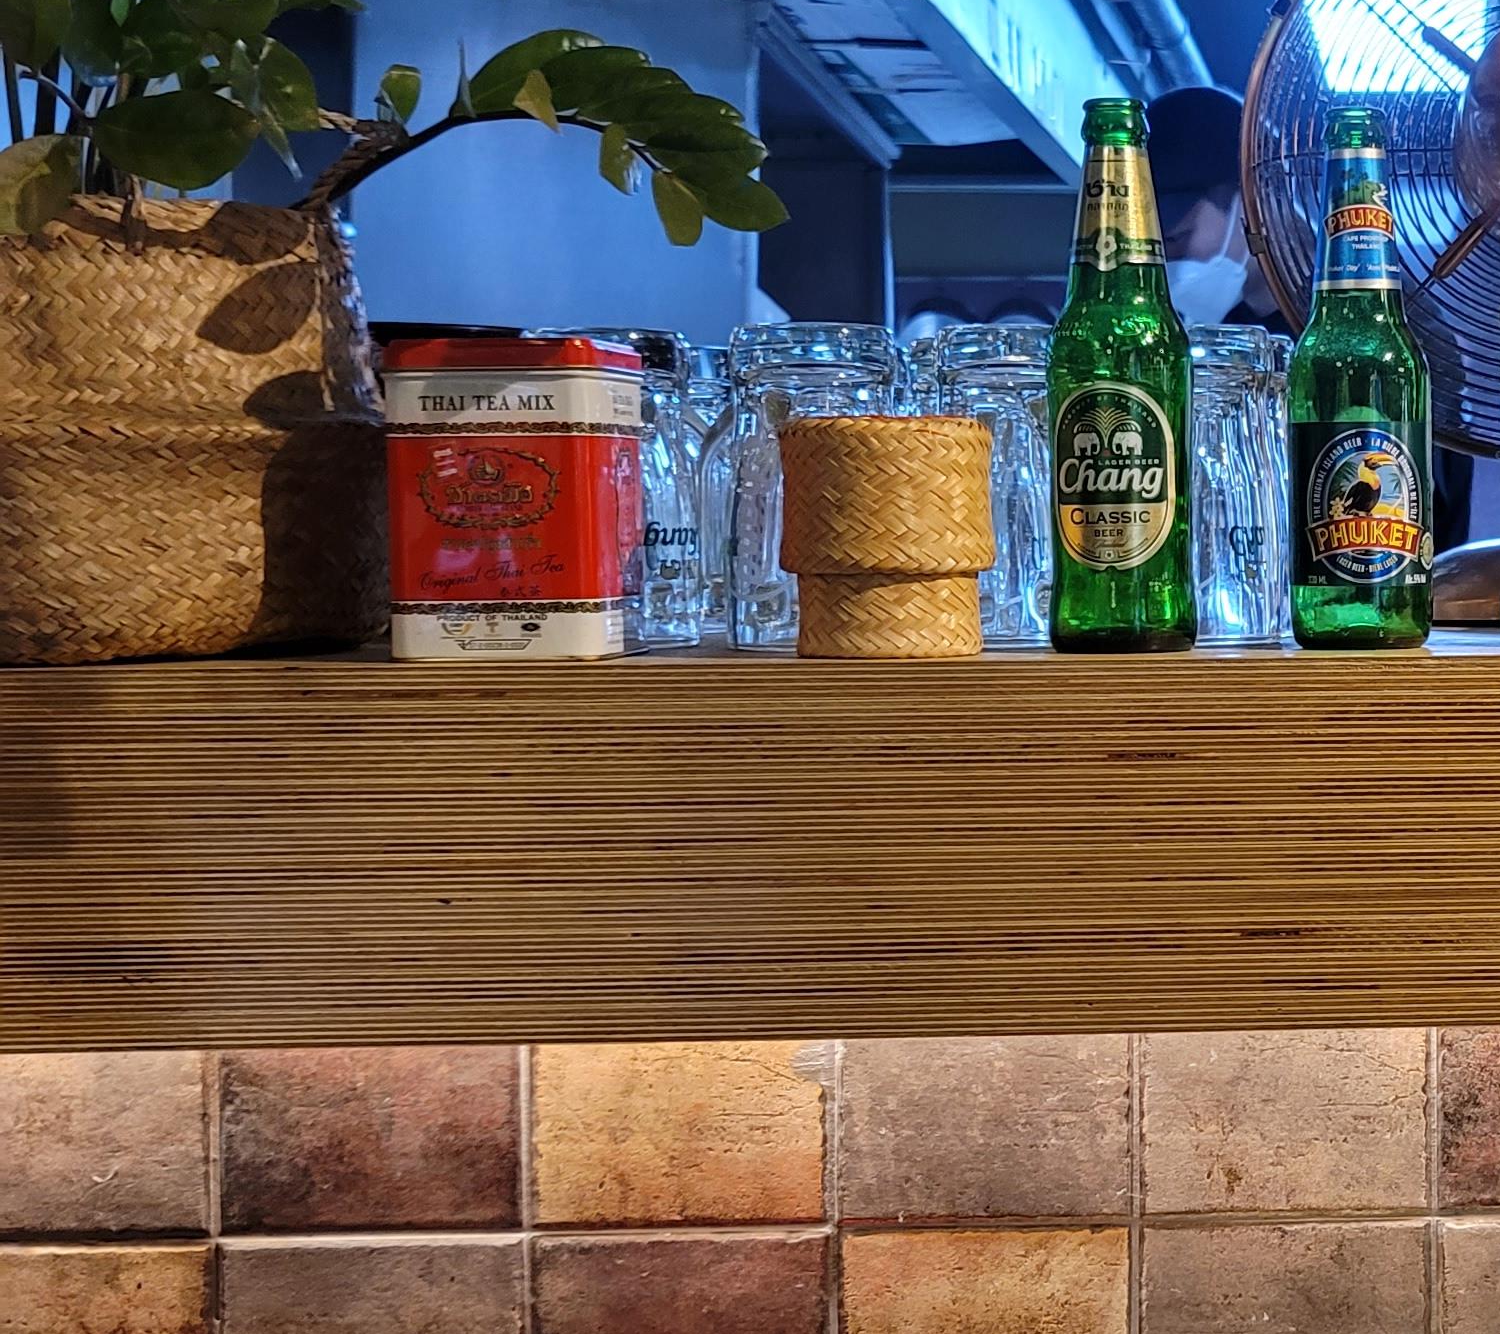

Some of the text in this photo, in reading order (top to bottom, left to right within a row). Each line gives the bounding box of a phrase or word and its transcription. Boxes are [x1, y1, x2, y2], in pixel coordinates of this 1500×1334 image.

[1327, 208, 1393, 234] PHUKET
[418, 394, 555, 411] THAI TEA MIX
[1097, 458, 1132, 466] LAGER
[1322, 445, 1344, 470] ISLAND
[1343, 436, 1362, 451] BEER
[1059, 457, 1164, 500] Chang
[1094, 528, 1124, 538] BEER
[1314, 520, 1418, 552] PHUKET
[420, 554, 565, 595] Original Thai Tea
[436, 612, 548, 622] PRODUCT OF THAILAND
